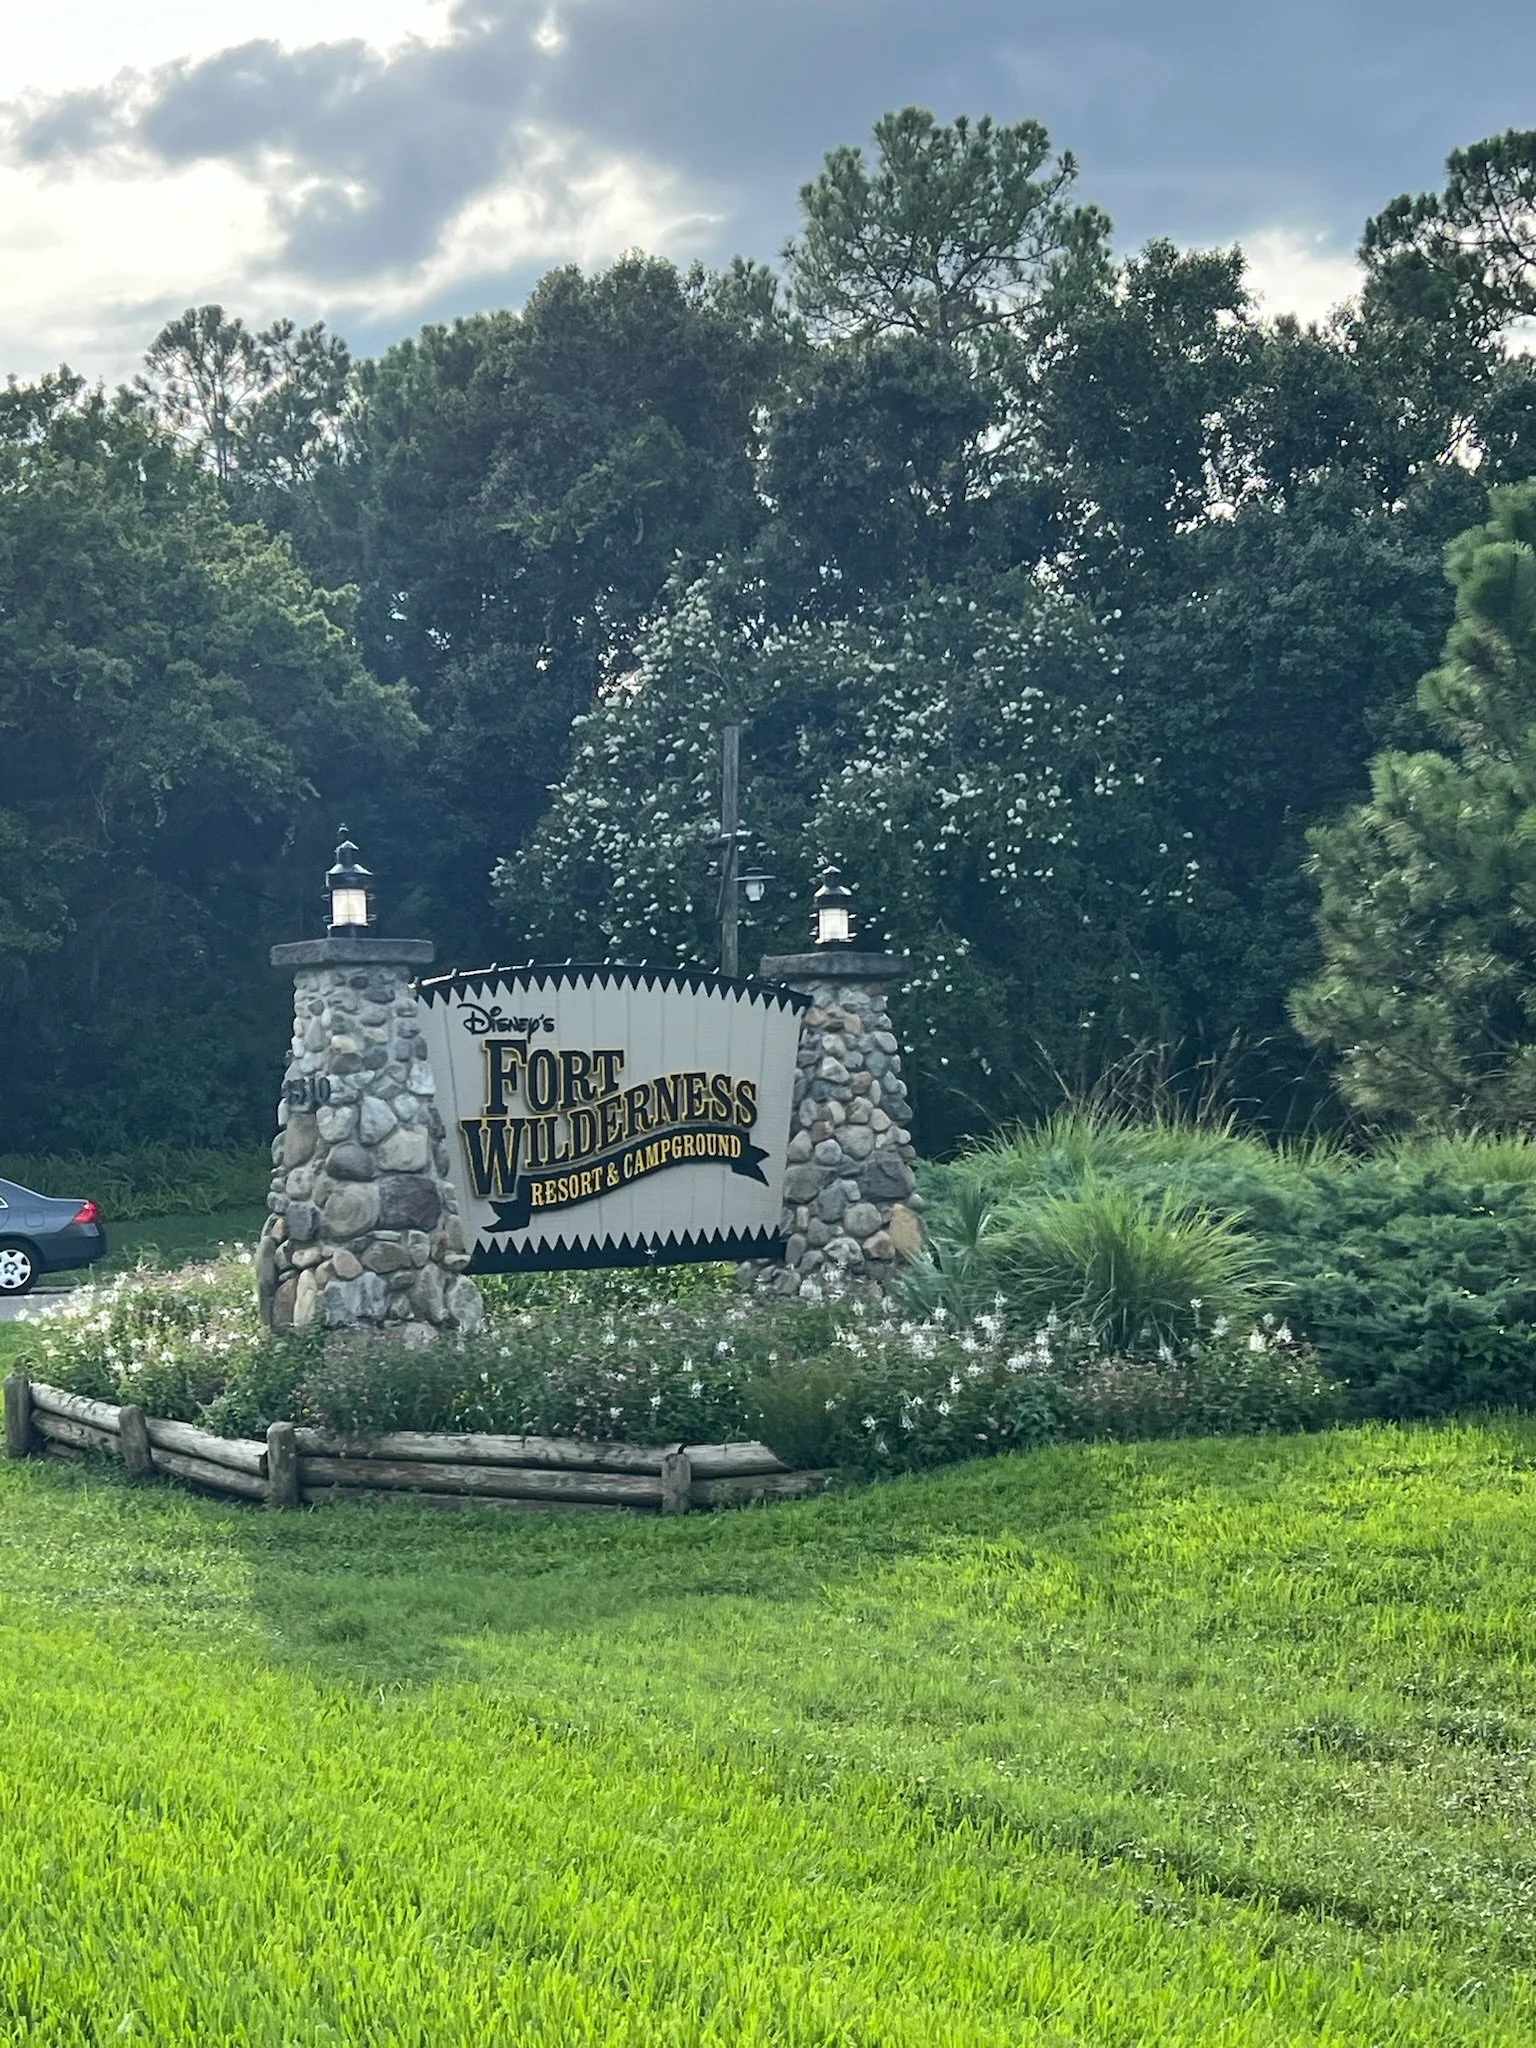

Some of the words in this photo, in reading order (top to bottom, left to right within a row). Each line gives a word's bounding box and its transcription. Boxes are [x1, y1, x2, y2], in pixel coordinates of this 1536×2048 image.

[482, 1037, 625, 1116] FORT
[460, 1071, 758, 1199] WILDERNESS
[530, 1167, 603, 1207] RESORT
[606, 1161, 620, 1187] &
[623, 1132, 743, 1181] CAMPGROUND
